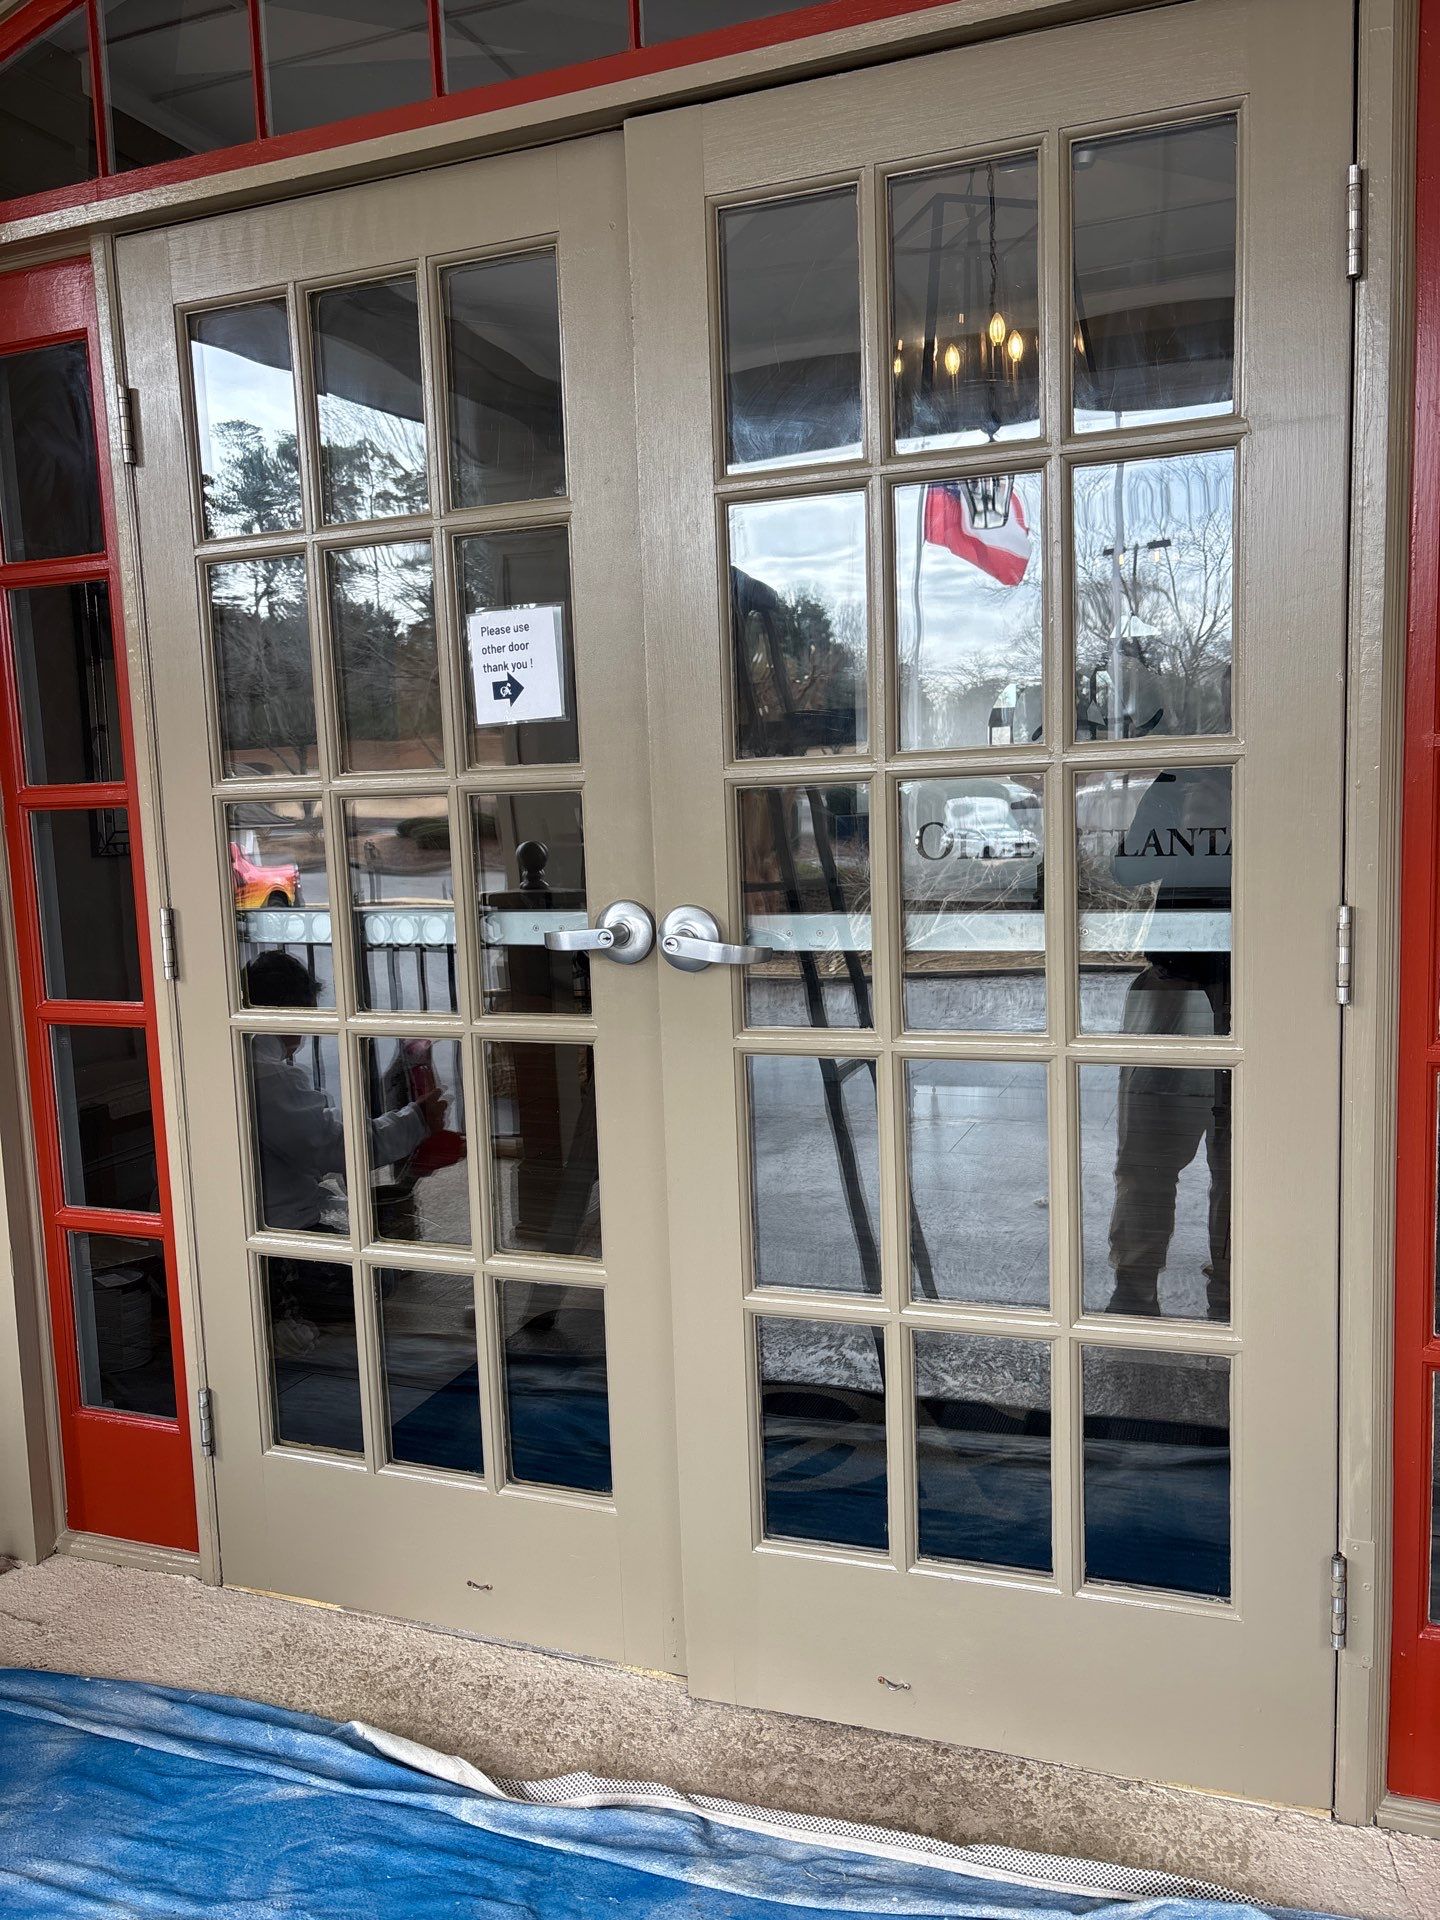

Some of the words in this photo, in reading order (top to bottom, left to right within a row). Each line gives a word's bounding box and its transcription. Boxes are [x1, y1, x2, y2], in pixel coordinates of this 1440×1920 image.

[480, 625, 511, 637] Please
[513, 623, 530, 633] use
[481, 644, 506, 655] other
[508, 641, 530, 652] door
[482, 661, 509, 673] thank
[511, 661, 528, 673] you
